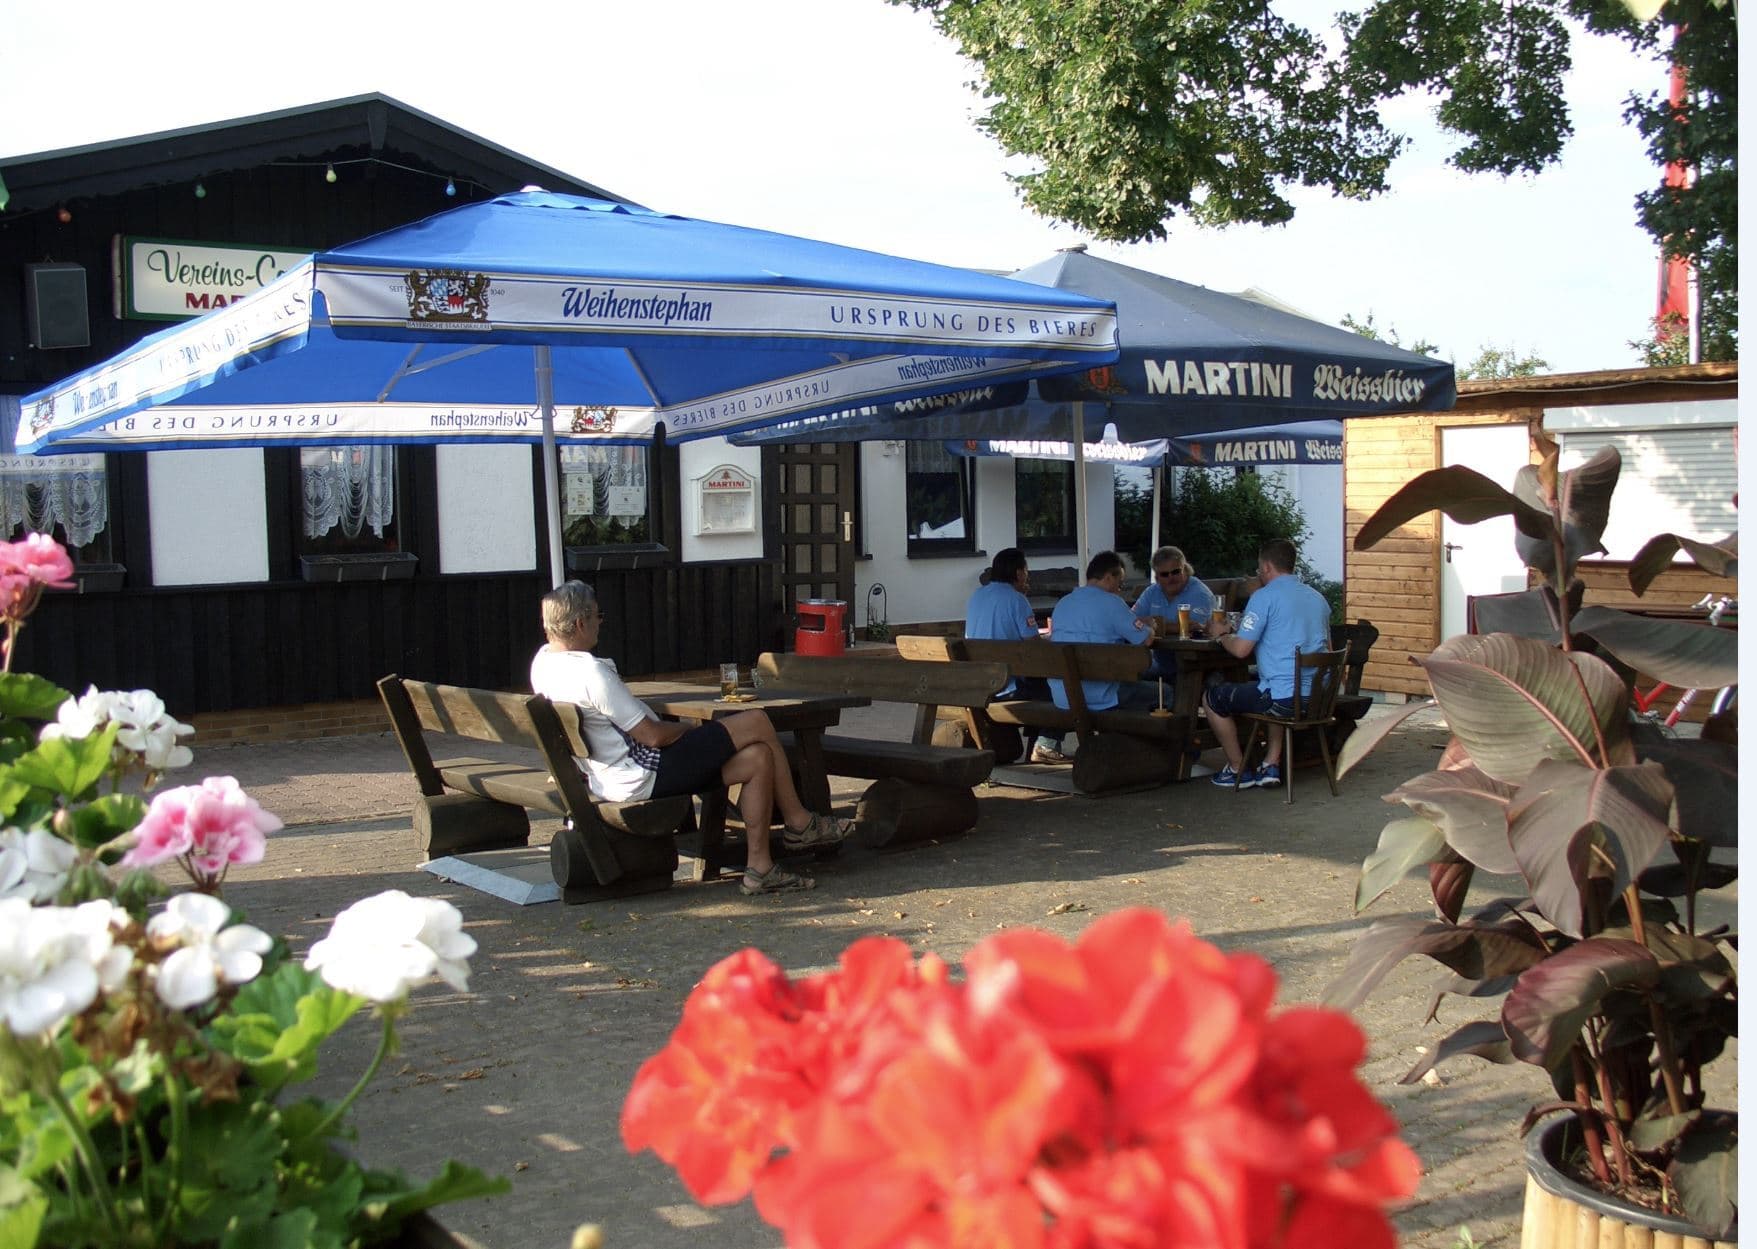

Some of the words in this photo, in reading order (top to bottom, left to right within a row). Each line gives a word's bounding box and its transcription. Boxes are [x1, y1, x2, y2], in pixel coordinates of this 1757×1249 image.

[561, 287, 712, 325] Weihenstephan
[831, 305, 963, 331] URSPRUNG
[978, 316, 1015, 333] DES
[1029, 319, 1096, 337] BIERES
[1144, 359, 1293, 398] MARTINI
[1313, 364, 1427, 403] Weissbier
[1215, 440, 1296, 461] MARTINI
[1304, 440, 1343, 460] Weiss
[708, 480, 745, 489] MARTINI
